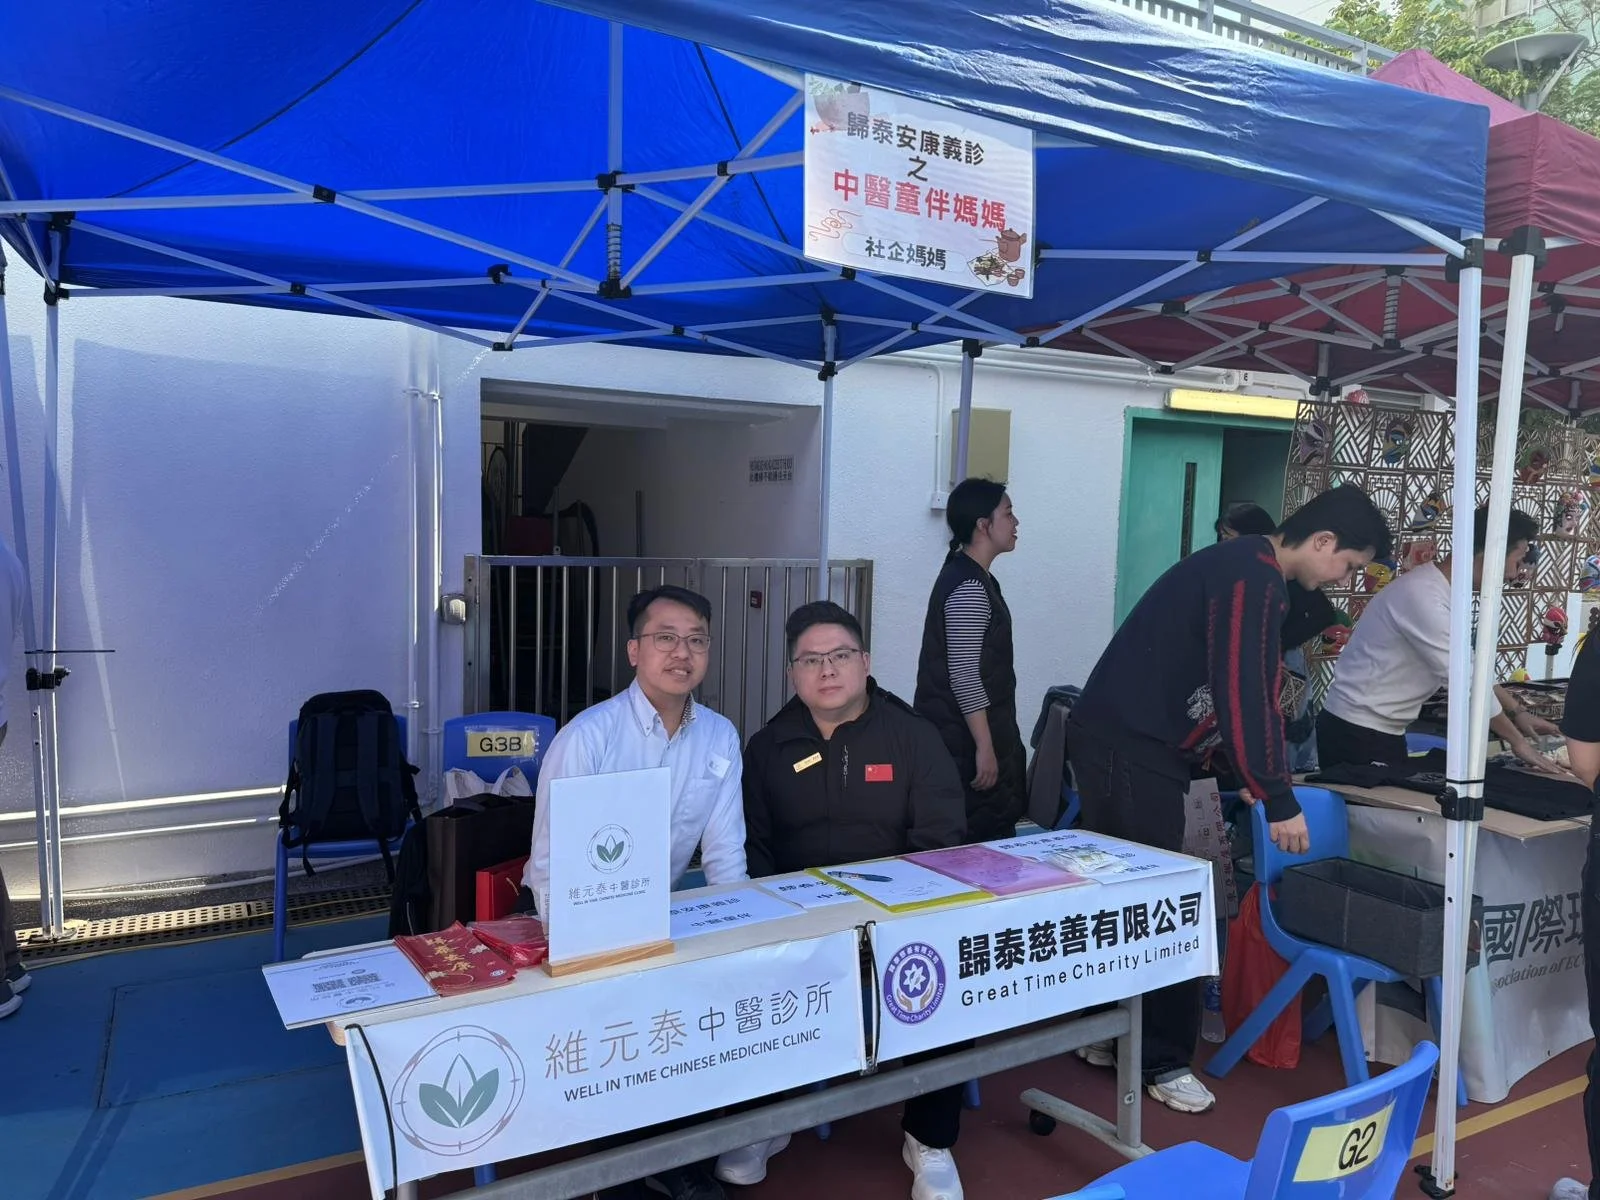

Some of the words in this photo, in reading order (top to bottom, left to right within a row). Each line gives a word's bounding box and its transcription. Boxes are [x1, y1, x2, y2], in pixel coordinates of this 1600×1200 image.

[847, 111, 984, 165] 歸泰安康義診
[907, 156, 928, 182] 之
[833, 168, 1006, 232] 中醫童伴媽媽
[865, 236, 947, 270] 社企媽媽
[480, 736, 522, 753] G3B
[958, 892, 1202, 979] 歸泰慈善有限公司
[961, 979, 1018, 1007] Great
[1024, 971, 1067, 992] Time
[1072, 953, 1140, 980] Charity
[1145, 935, 1200, 964] Limited
[910, 1008, 932, 1022] Charity
[930, 983, 944, 1009] Limited
[545, 981, 832, 1080] 維元泰中醫診所
[564, 1082, 603, 1102] WELL
[606, 1078, 620, 1093] IN
[624, 1069, 657, 1087] TIME
[660, 1055, 716, 1079] CHINESE
[719, 1038, 779, 1064] MEDICINE
[782, 1028, 821, 1048] CLINIC
[1338, 1121, 1377, 1170] G2
